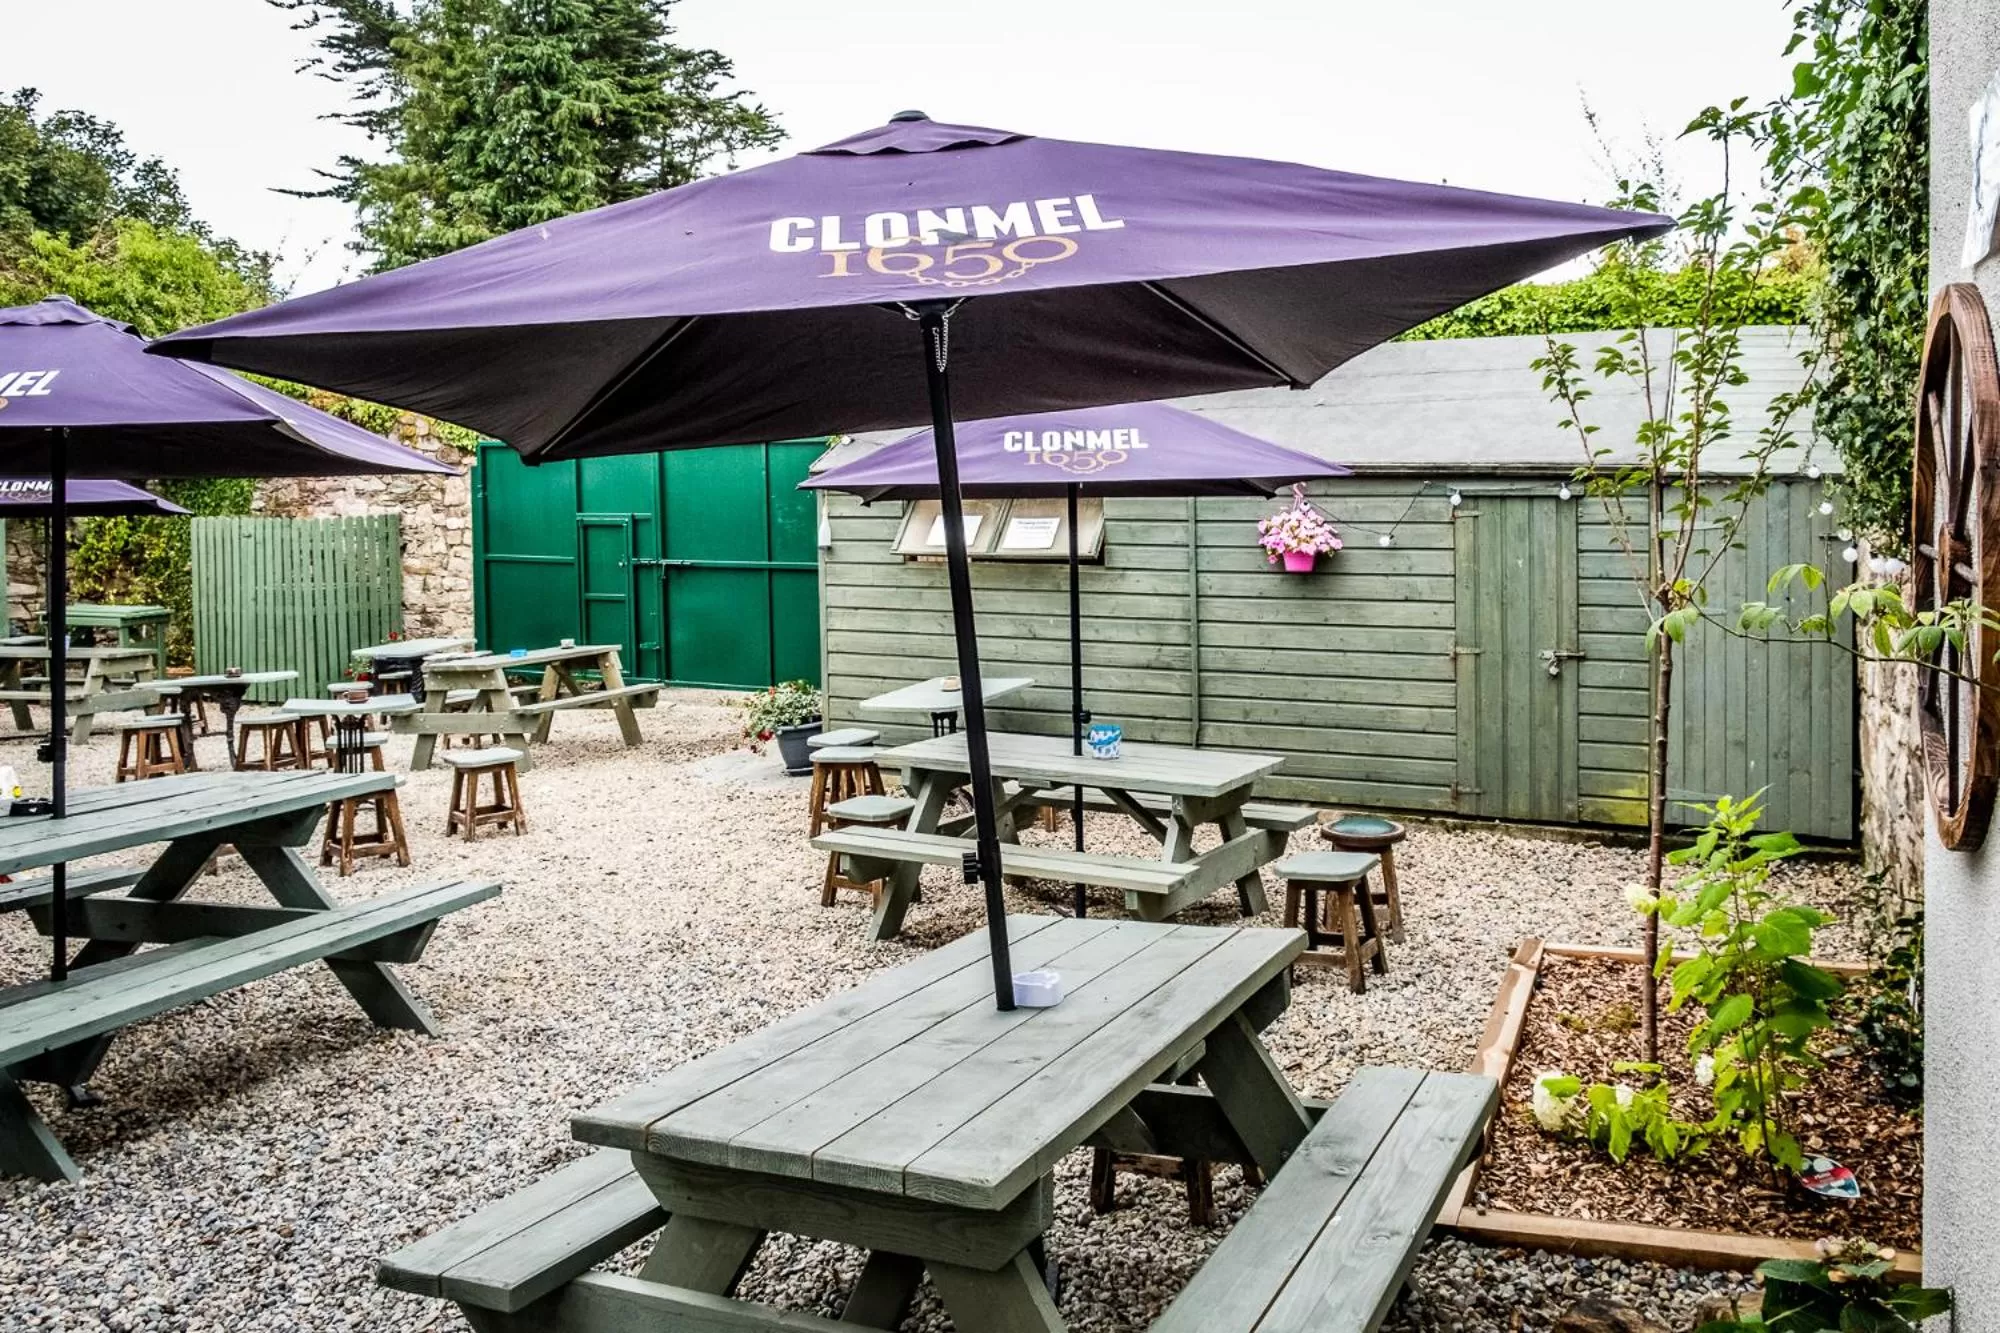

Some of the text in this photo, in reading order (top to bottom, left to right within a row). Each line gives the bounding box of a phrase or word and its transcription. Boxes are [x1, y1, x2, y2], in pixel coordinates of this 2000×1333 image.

[768, 193, 1125, 253] CLONMEL
[817, 235, 1079, 279] 1650
[1003, 428, 1149, 452] CLONMEL
[1024, 449, 1128, 470] 1650
